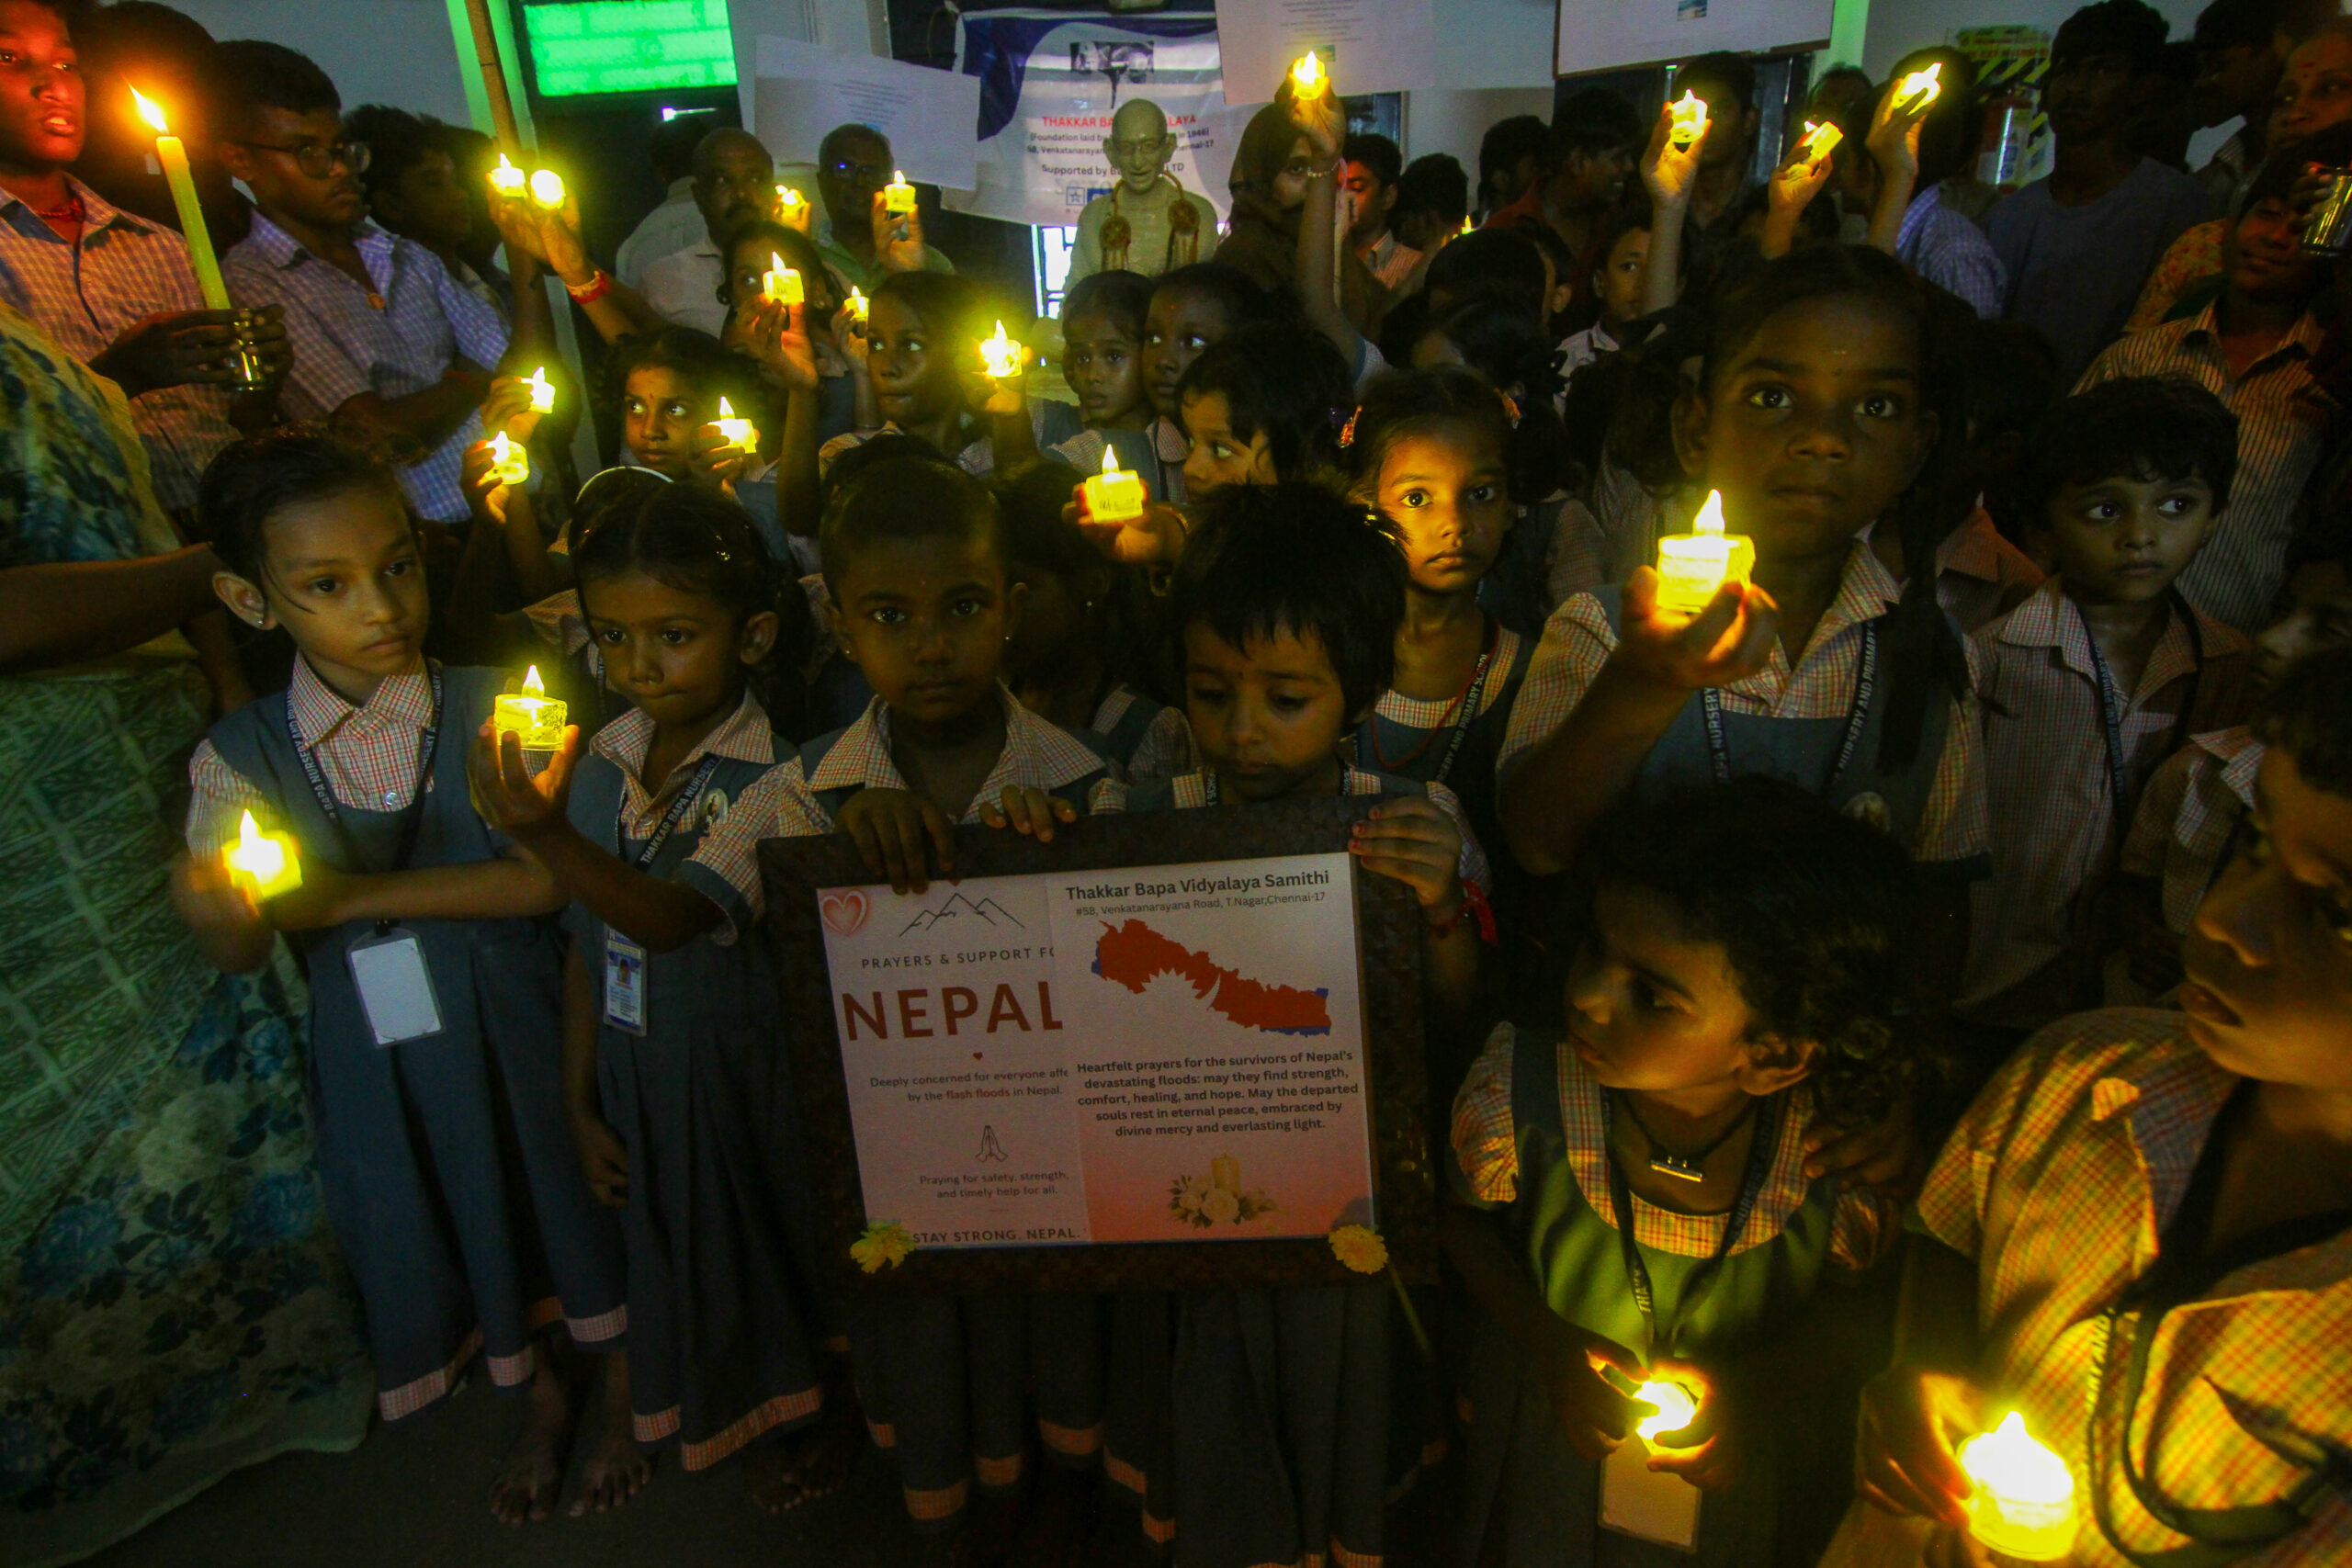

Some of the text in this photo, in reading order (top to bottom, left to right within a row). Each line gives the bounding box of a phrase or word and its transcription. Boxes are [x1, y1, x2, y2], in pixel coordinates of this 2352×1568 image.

[1042, 116, 1097, 127] THAKKAR
[1042, 164, 1093, 176] Supported
[1095, 165, 1108, 177] by
[1457, 684, 1480, 729] PRIMARY
[1837, 629, 1875, 769] NURSERY AND PRIMARY
[1702, 686, 1724, 750] NURSERY
[639, 759, 717, 863] THAKKAR BAPA NURSERY
[1065, 870, 1329, 900] Thakkar Bapa Vidyalaya Samithi
[1101, 902, 1191, 915] Venkatanarayana
[1193, 897, 1224, 908] Road,
[1226, 891, 1326, 908] T.Nagar,Chennai-17
[861, 954, 932, 969] PRAYERS
[940, 953, 950, 964] &
[956, 947, 1032, 964] SUPPORT
[842, 982, 1063, 1040] NEPAL
[1077, 1050, 1353, 1074] Heartfelt prayers for the survivors of Nepal's
[870, 1077, 910, 1089] Deeply
[912, 1073, 971, 1085] concerned
[974, 1072, 990, 1082] for
[993, 1071, 1046, 1081] everyone
[1084, 1066, 1349, 1089] devastating floods: may they find strength,
[907, 1085, 1063, 1103] by the flash floods in Nepal.
[1077, 1083, 1359, 1106] comfort, healing, and hope. May the departed
[1095, 1100, 1342, 1122] souls rest in eternal peace, embraced by
[1114, 1118, 1326, 1137] divine mercy and everlasting light.
[920, 1175, 960, 1186] Praying
[963, 1174, 978, 1183] for
[936, 1185, 1057, 1199] and timely help for all.
[911, 1232, 948, 1244] STAY
[1026, 1227, 1080, 1239] NEPAL.
